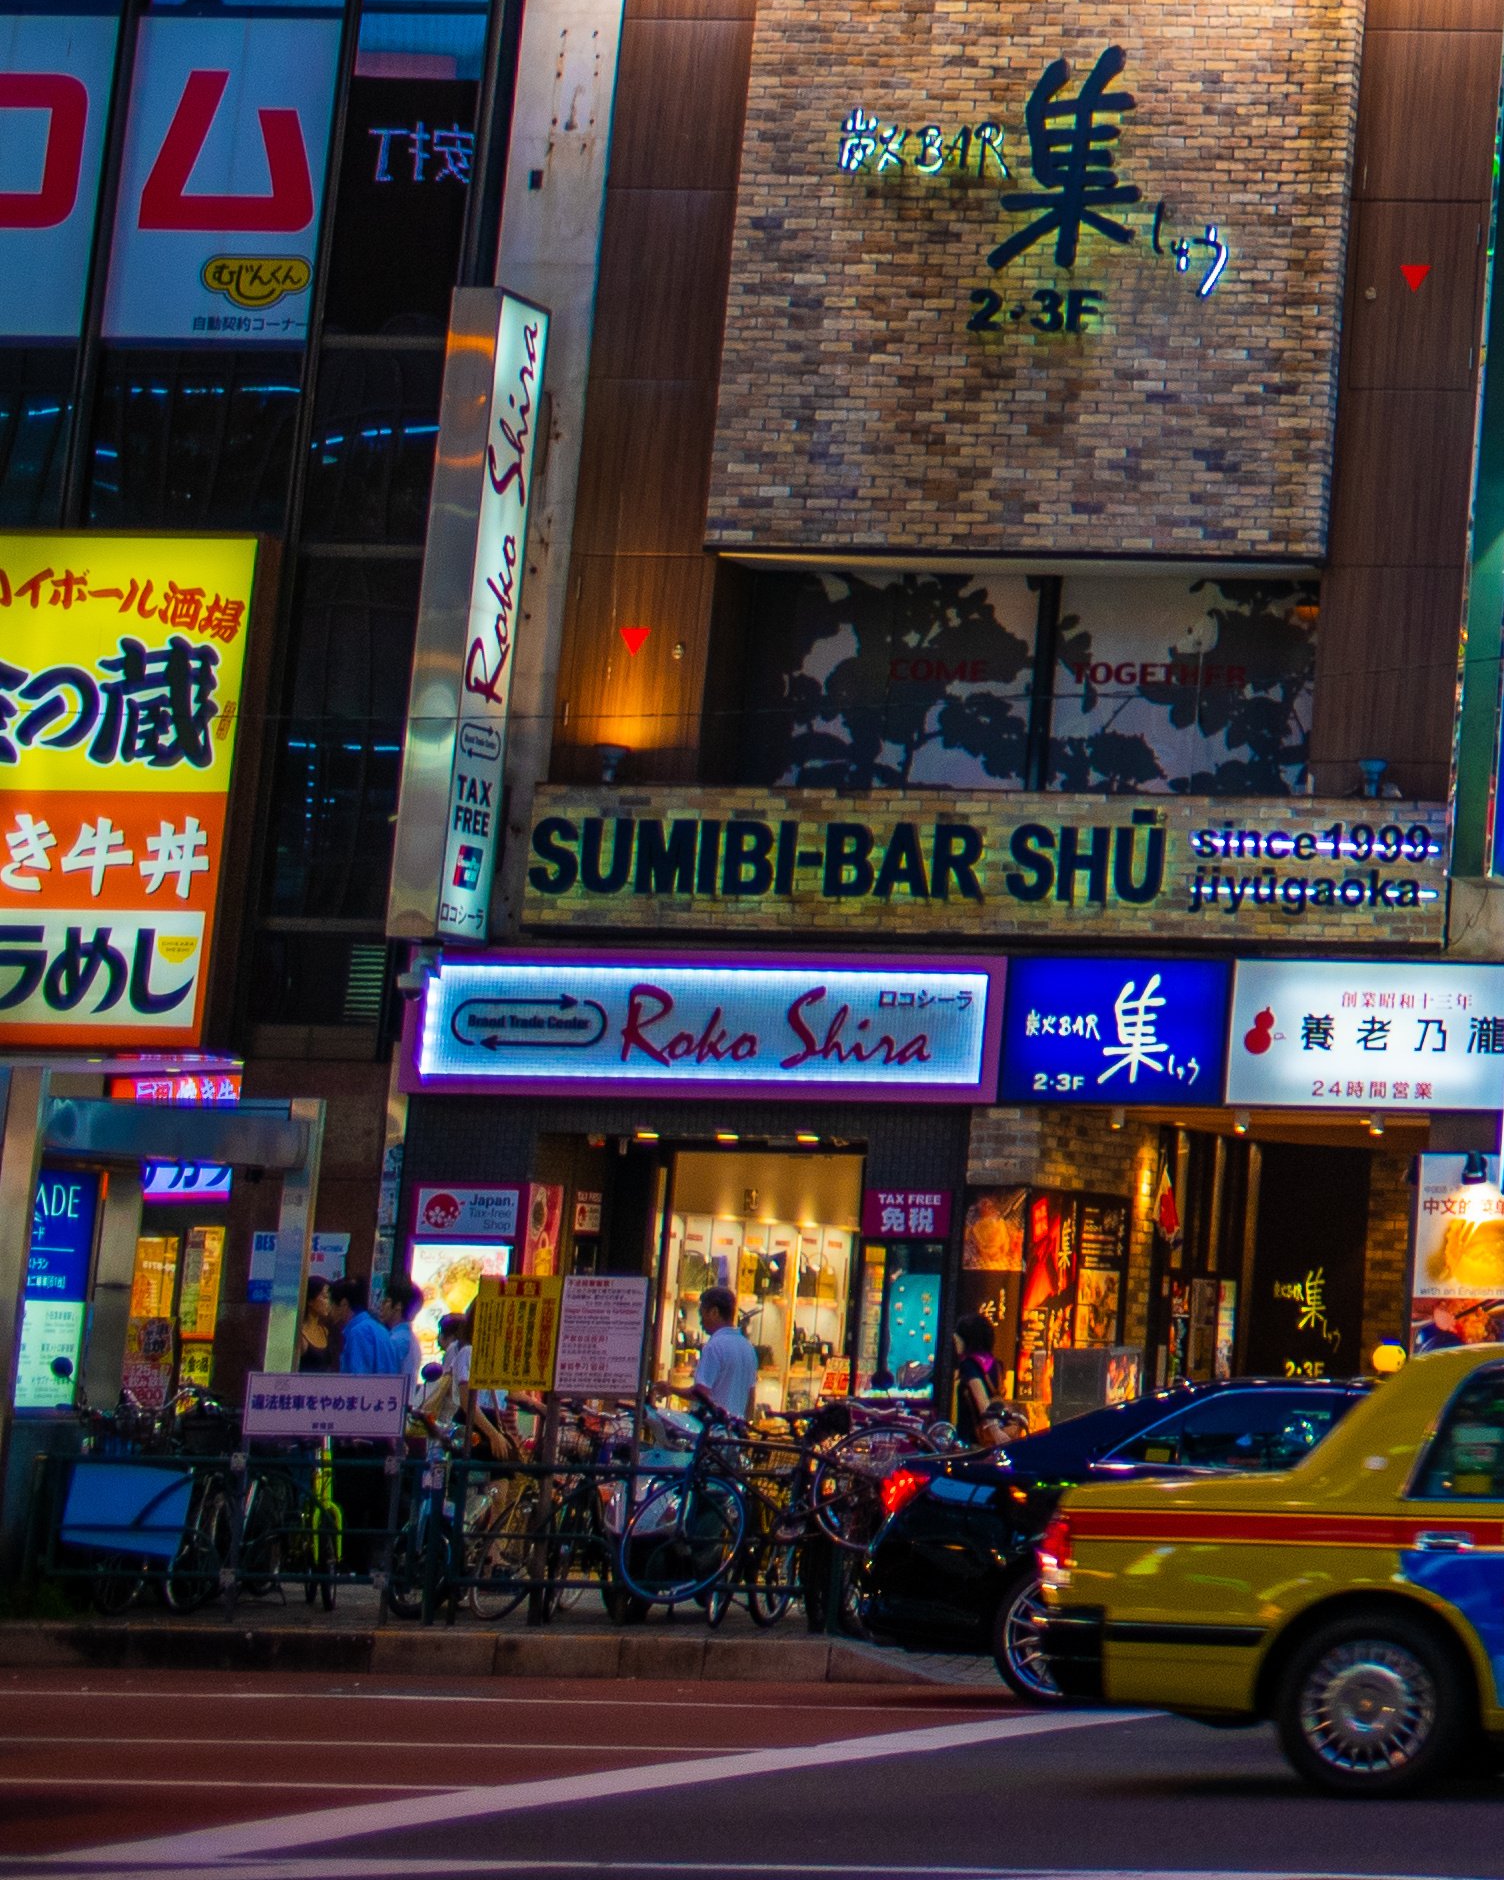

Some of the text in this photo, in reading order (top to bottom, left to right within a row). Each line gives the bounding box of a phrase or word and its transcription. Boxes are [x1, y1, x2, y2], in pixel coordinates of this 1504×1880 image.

[986, 44, 1142, 269] 集
[457, 774, 493, 809] TAX
[453, 810, 491, 839] FREE
[529, 809, 1163, 906] SUMIBI-BAR SHŪ
[619, 983, 933, 1071] Roko Shira
[878, 988, 974, 1009] ロコシーラ
[1095, 971, 1167, 1085] 集
[1309, 1078, 1434, 1101] 24時間営業
